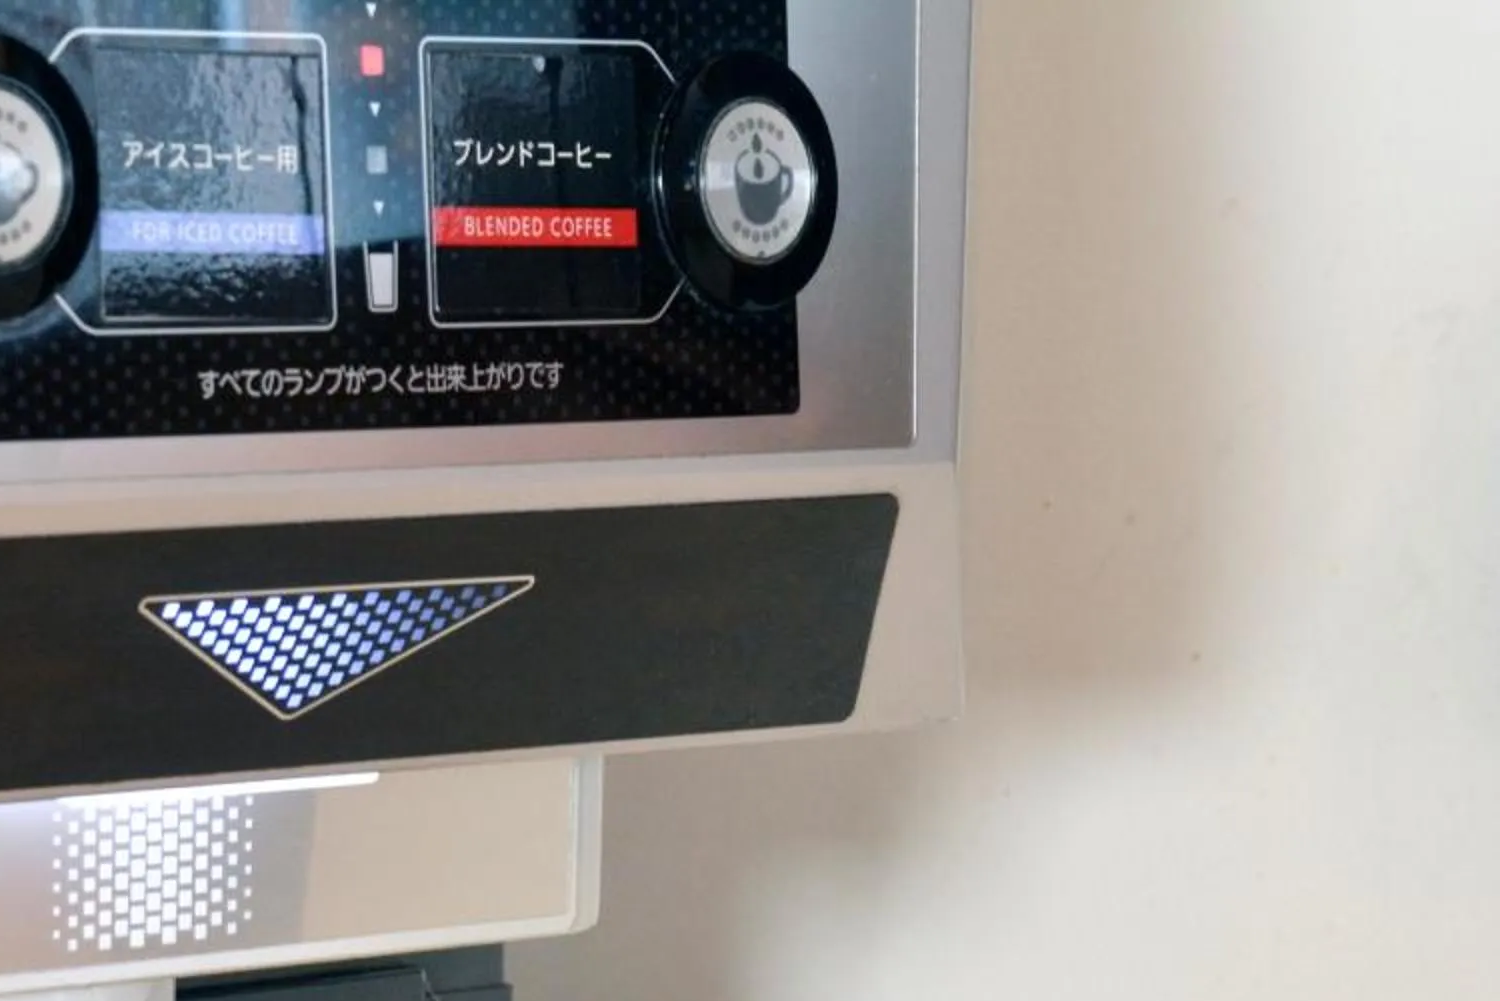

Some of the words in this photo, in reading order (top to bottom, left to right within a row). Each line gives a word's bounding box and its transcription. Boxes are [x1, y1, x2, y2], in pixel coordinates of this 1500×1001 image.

[122, 140, 298, 174] アイスコーヒー用
[453, 138, 612, 168] ブレンドコーヒー
[133, 220, 171, 242] FOR
[177, 220, 223, 243] ICED
[228, 222, 299, 245] COFFEE
[463, 215, 544, 237] BLENDED
[550, 216, 613, 239] COFFEE
[198, 361, 564, 399] すべてのランプがつくと出来上がりです
